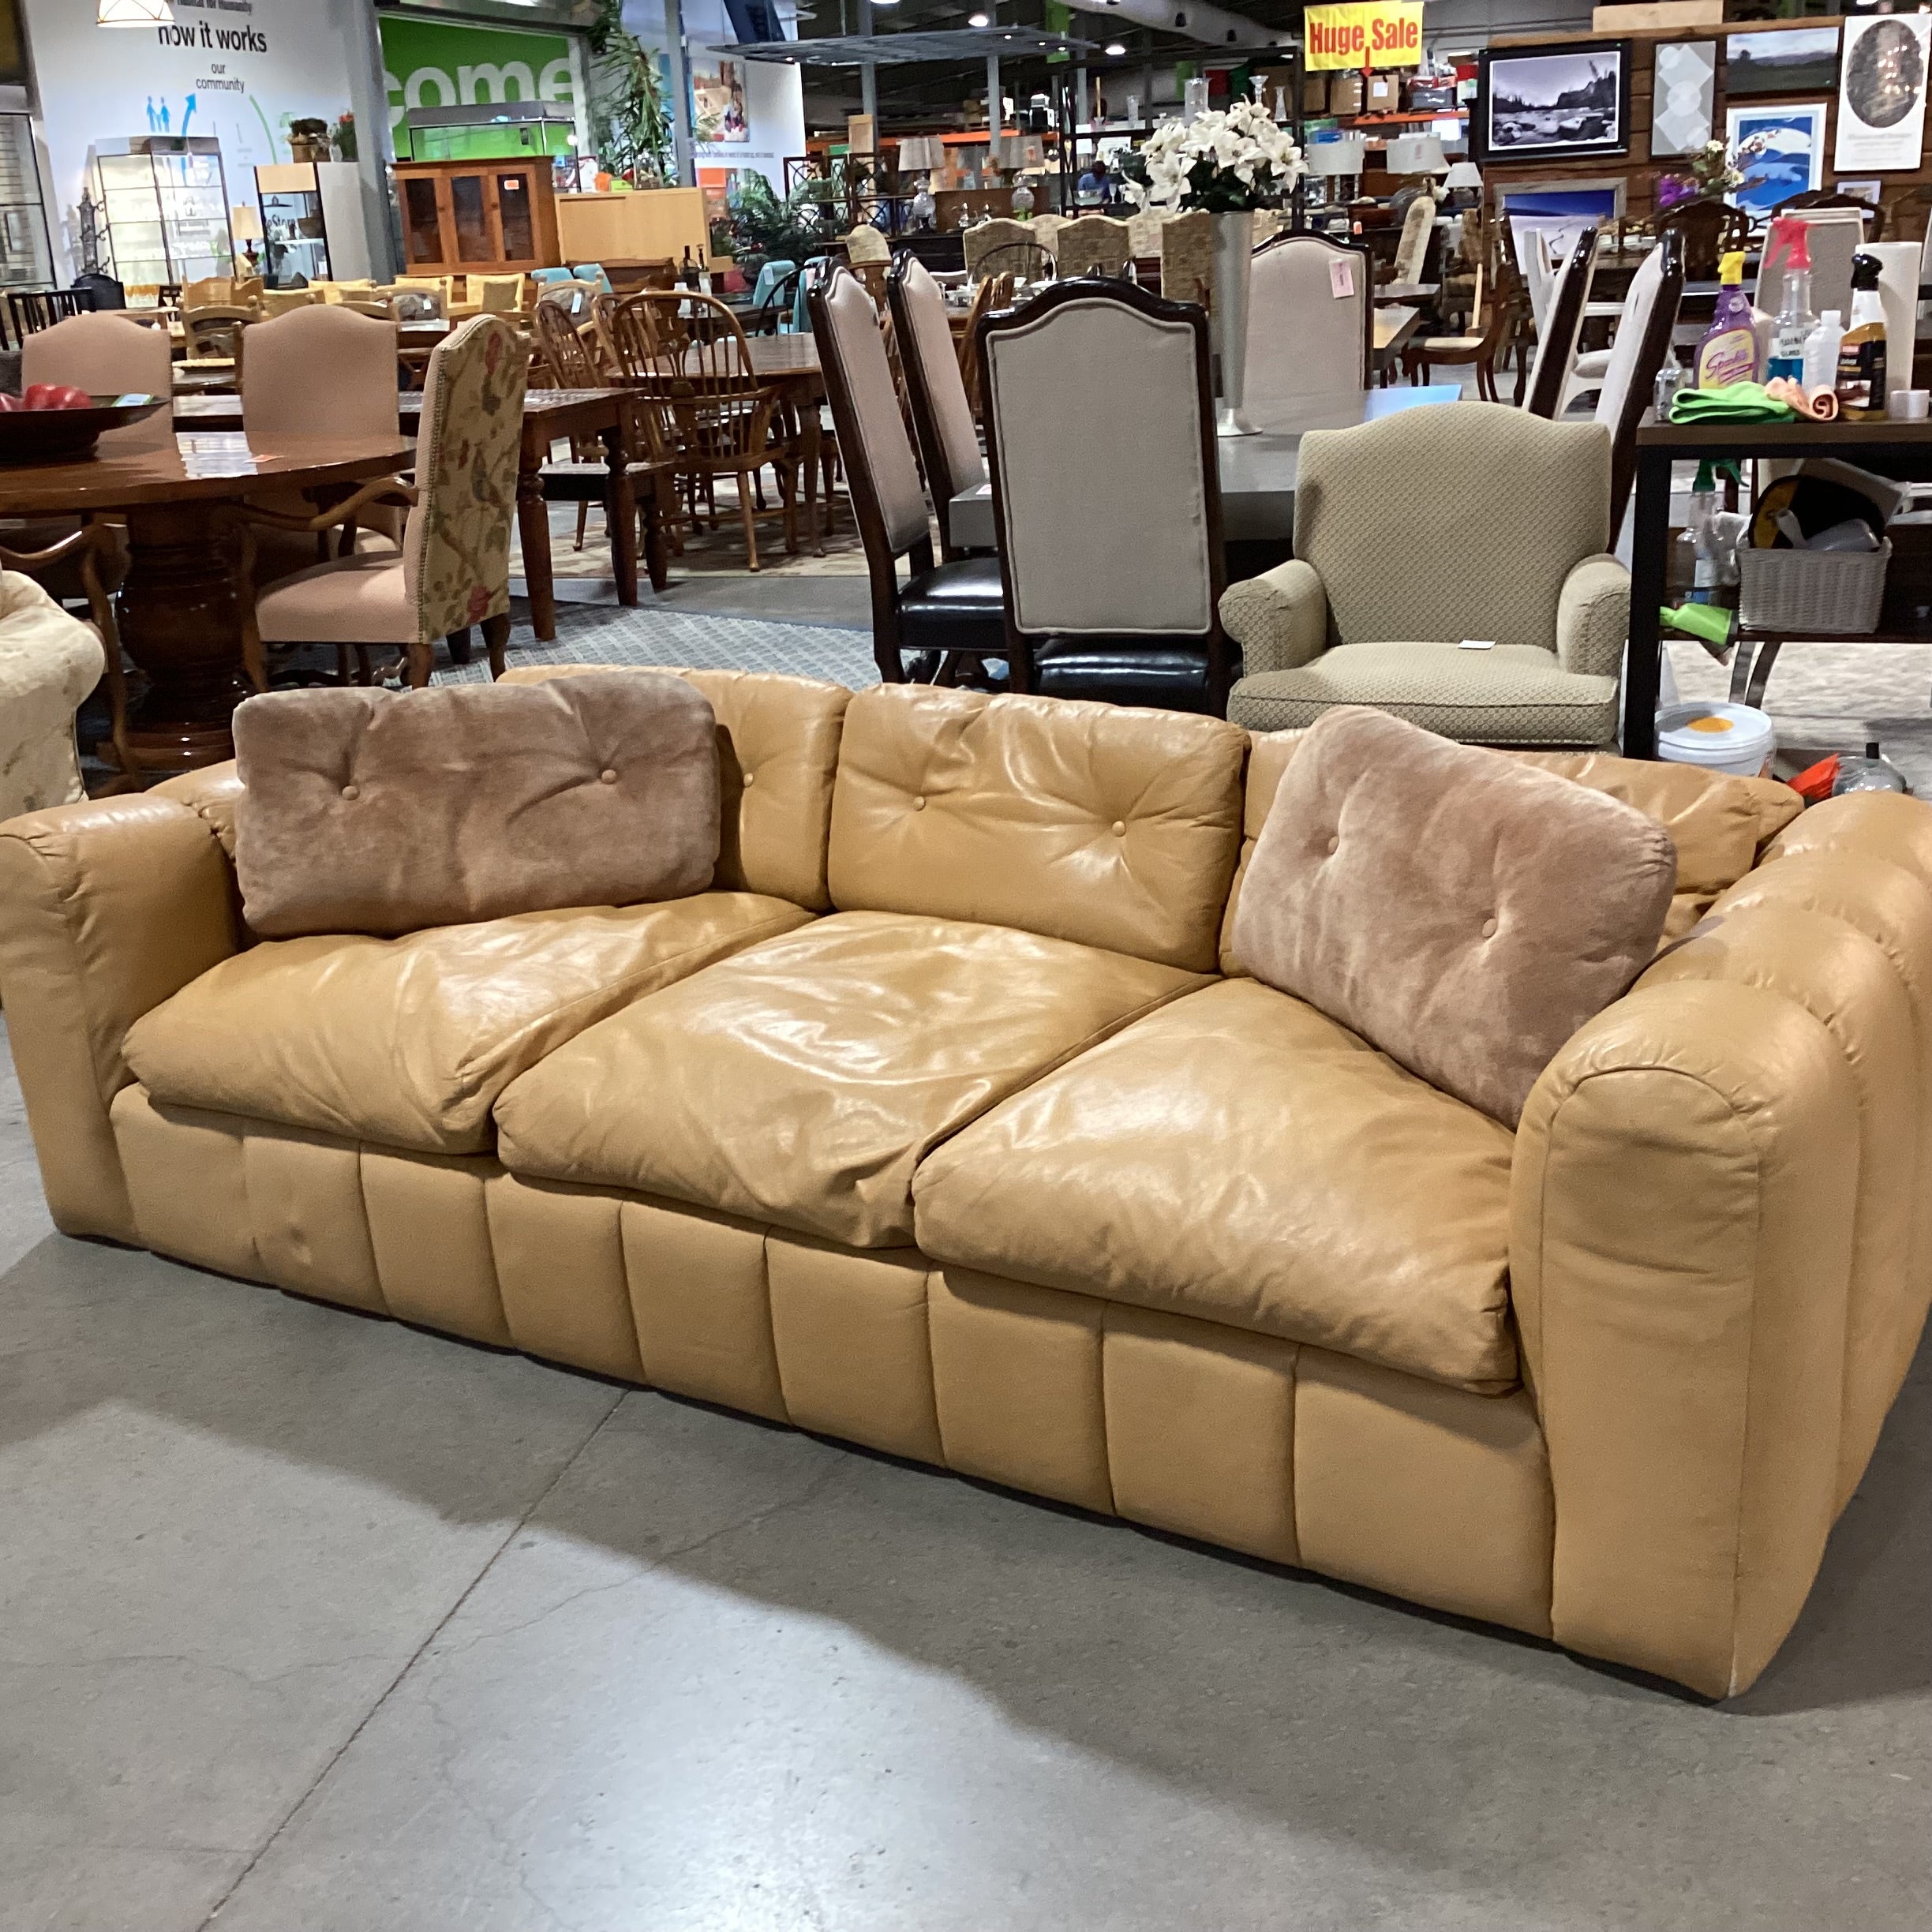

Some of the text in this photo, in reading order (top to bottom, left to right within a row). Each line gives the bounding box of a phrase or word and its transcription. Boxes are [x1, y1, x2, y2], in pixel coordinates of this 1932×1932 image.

[199, 20, 213, 48] it
[215, 24, 268, 53] works
[1309, 17, 1418, 55] Huge Sale
[211, 63, 226, 74] our
[196, 77, 245, 94] community
